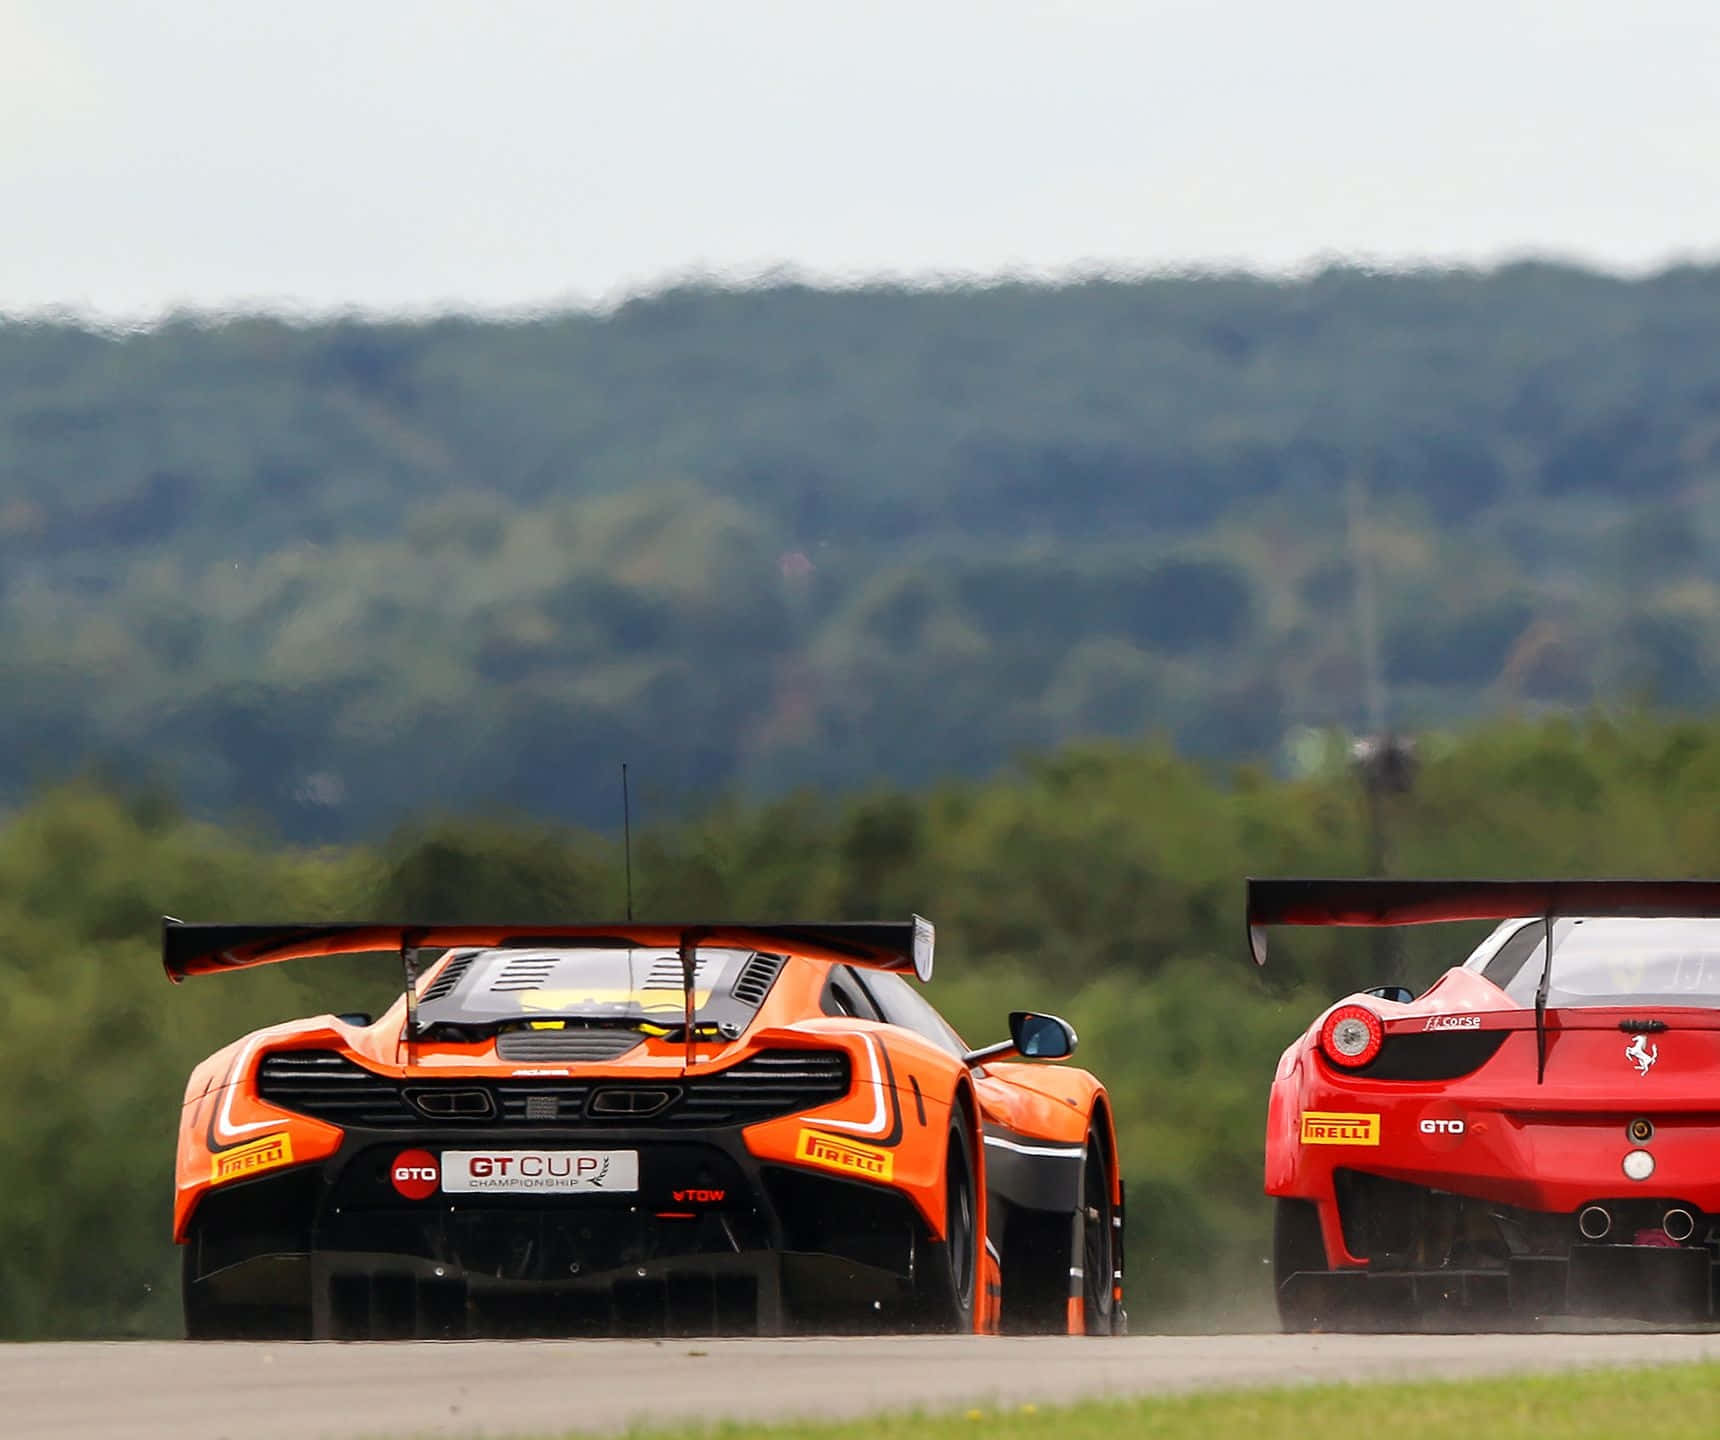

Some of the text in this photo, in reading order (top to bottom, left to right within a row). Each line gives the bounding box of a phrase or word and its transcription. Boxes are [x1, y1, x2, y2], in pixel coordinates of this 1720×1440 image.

[1304, 1117, 1371, 1139] PIRELLI
[1420, 1119, 1464, 1133] GTO
[217, 1140, 282, 1177] PIRELLI
[805, 1135, 885, 1174] PIRELLI
[395, 1167, 437, 1180] GTO
[468, 1156, 598, 1178] GT CUP
[468, 1179, 579, 1188] CHAMPIONSHIP
[686, 1189, 725, 1202] TOW
